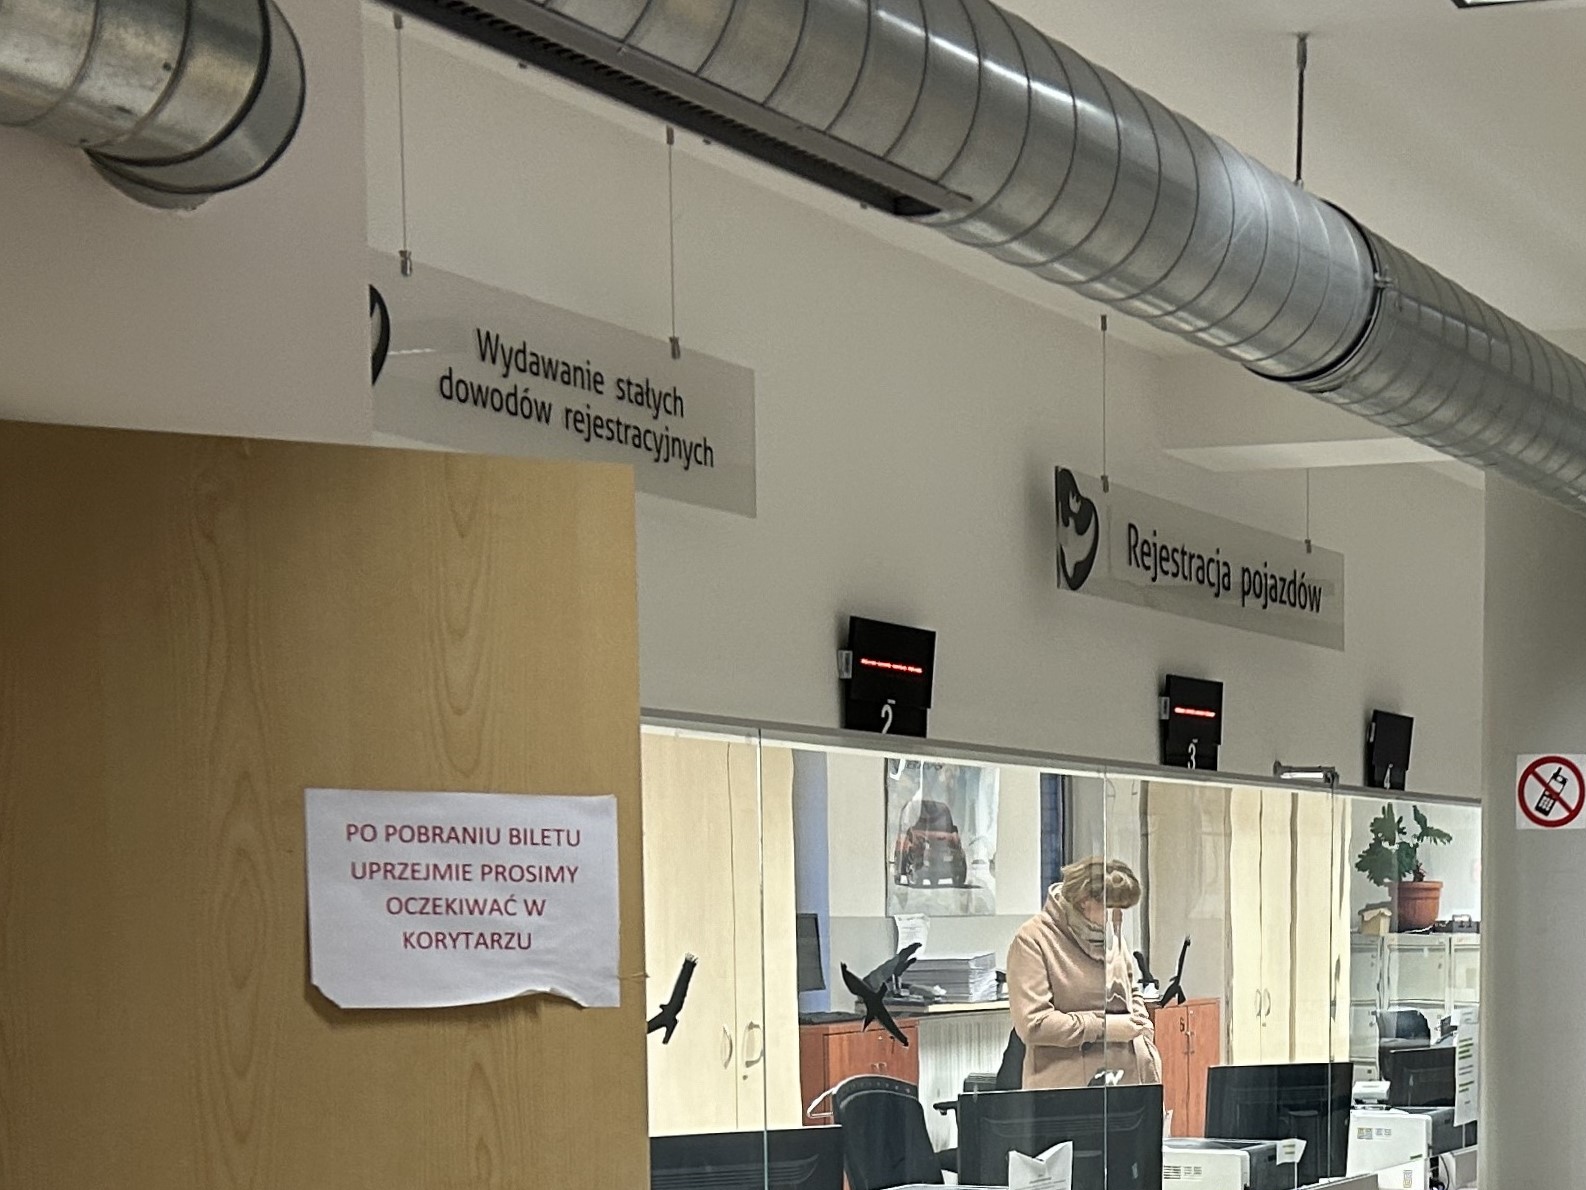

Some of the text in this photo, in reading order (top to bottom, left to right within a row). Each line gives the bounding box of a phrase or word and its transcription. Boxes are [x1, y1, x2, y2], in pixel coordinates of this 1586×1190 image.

[476, 327, 685, 419] Wydawanie stałych
[438, 367, 715, 471] dowodów rejestracyjnych
[1127, 522, 1322, 613] Rejestracja pojazdów
[345, 823, 581, 847] PO POBRANIU BILETU
[350, 861, 579, 884] UPRZEJMIE PROSIMY
[386, 895, 546, 917] OCZEKIWAĆ W
[402, 931, 533, 950] KORYTARZU
